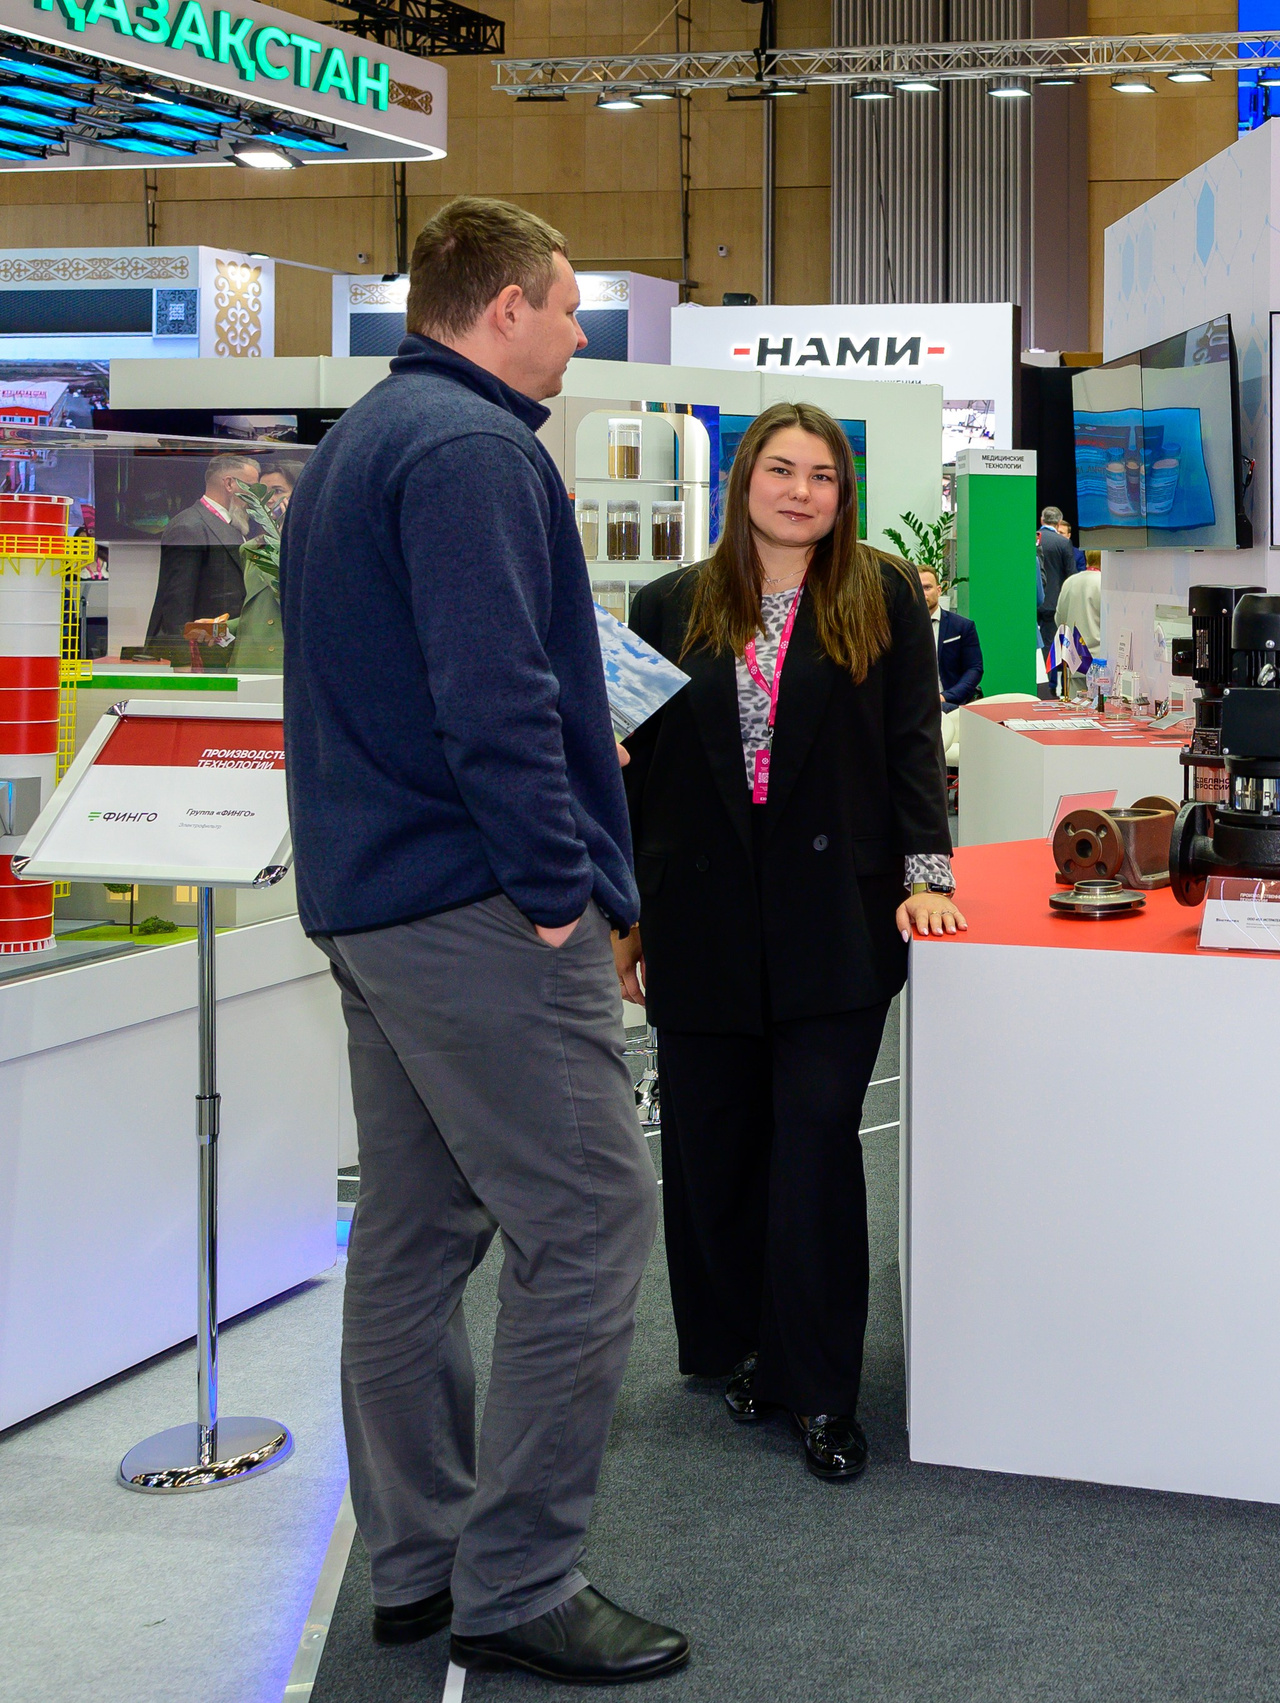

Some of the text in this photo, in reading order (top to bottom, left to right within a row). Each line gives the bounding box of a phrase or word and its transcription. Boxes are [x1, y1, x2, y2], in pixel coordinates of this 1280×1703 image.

[34, 0, 389, 112] АЗАҚСТАН
[756, 337, 921, 366] НАМИ
[197, 760, 274, 769] ТЕХНОЛОГИИ
[103, 812, 158, 822] ФИНГО
[186, 809, 214, 817] Группа
